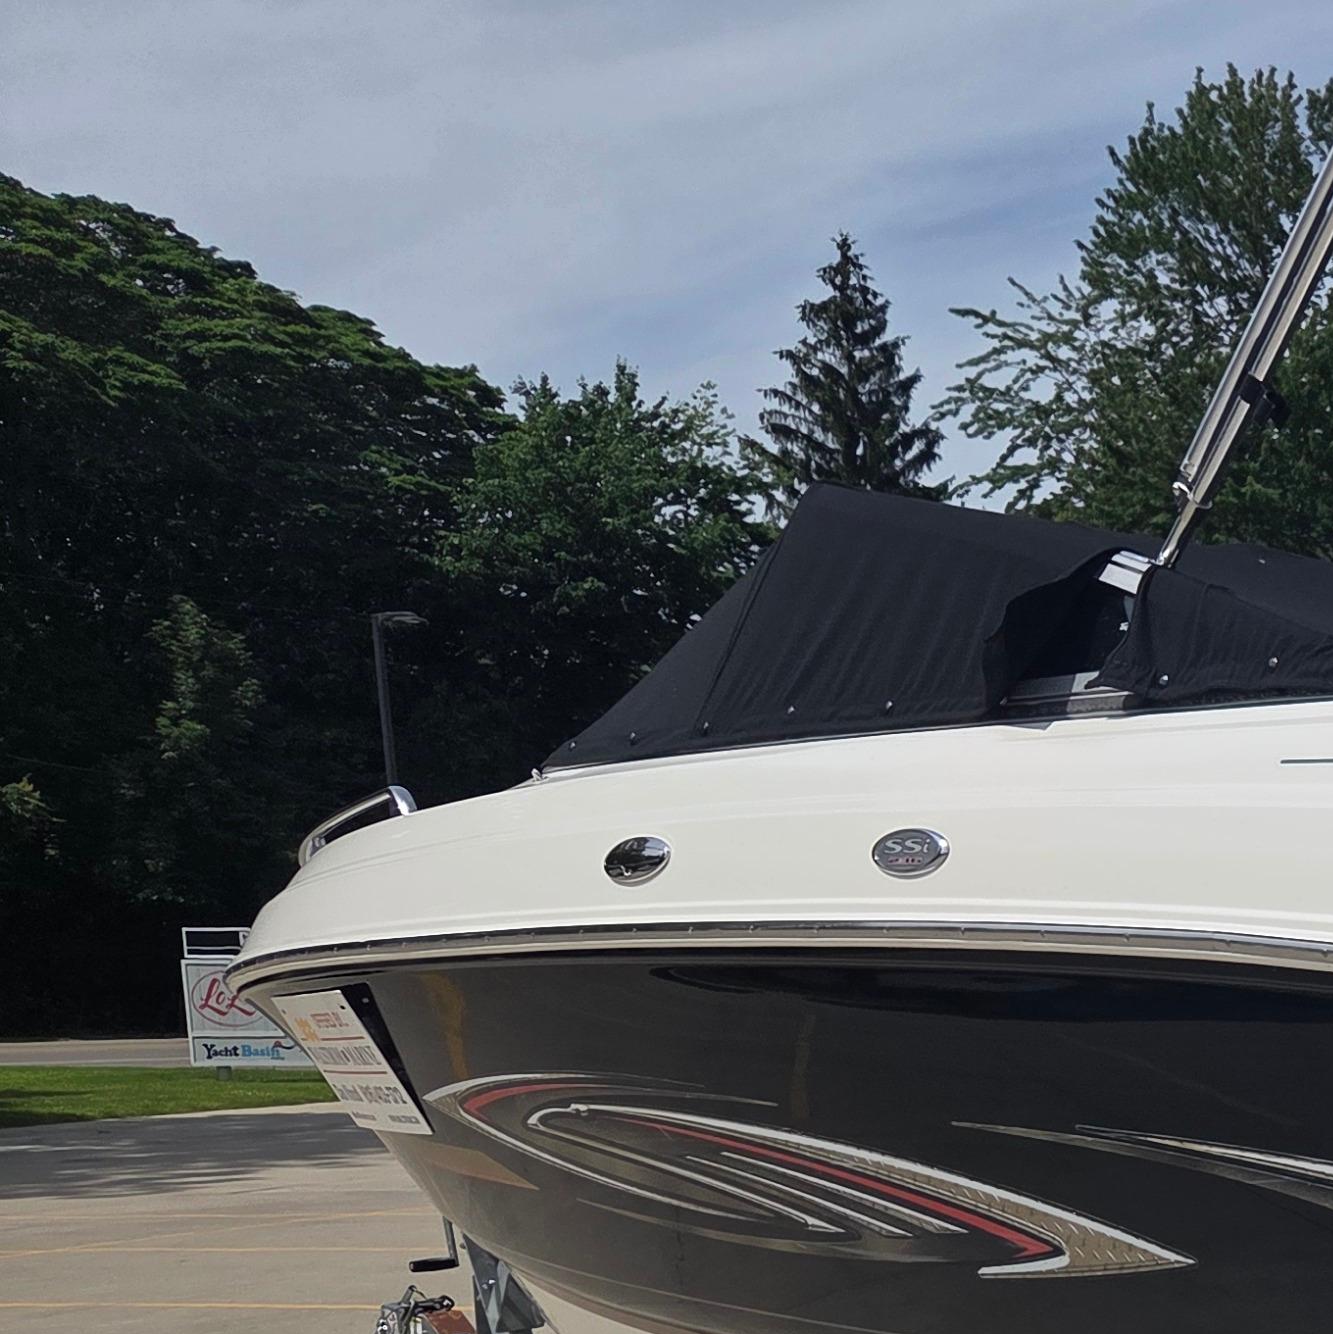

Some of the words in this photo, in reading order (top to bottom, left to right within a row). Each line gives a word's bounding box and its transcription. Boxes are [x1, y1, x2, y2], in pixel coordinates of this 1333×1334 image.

[884, 838, 930, 854] SSi
[202, 1043, 240, 1060] Yacht
[241, 1044, 281, 1058] Basin
